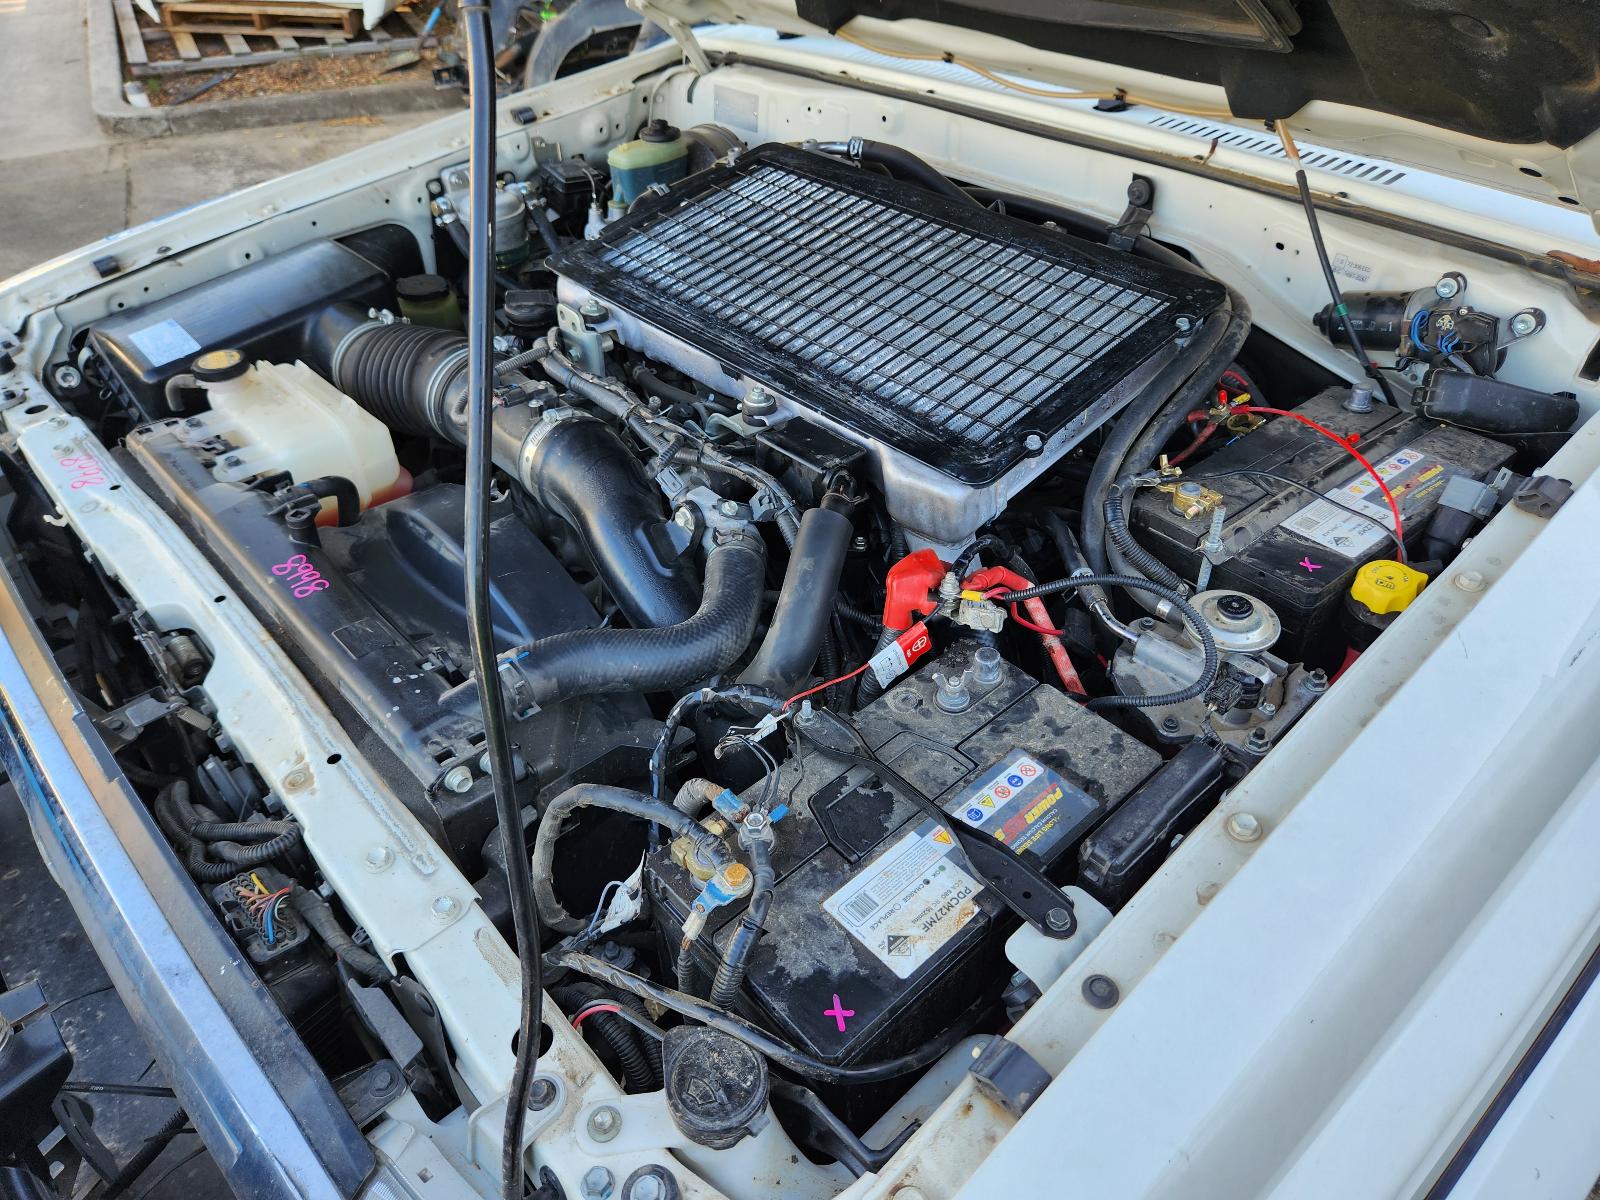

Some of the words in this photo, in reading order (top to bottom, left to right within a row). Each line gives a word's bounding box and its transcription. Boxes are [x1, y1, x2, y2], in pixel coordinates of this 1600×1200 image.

[272, 554, 329, 598] 8998
[1022, 787, 1064, 824] POWER
[1039, 807, 1058, 823] CALCIUM
[1023, 820, 1043, 837] CALCIUM
[1040, 817, 1058, 832] LONG
[1029, 829, 1044, 842] LIFE
[930, 869, 941, 878] OK
[950, 878, 963, 890] CCA
[900, 882, 925, 904] CHARGE
[921, 886, 974, 932] PDCM27MF
[930, 898, 941, 908] RC
[868, 907, 896, 931] REPLACE
